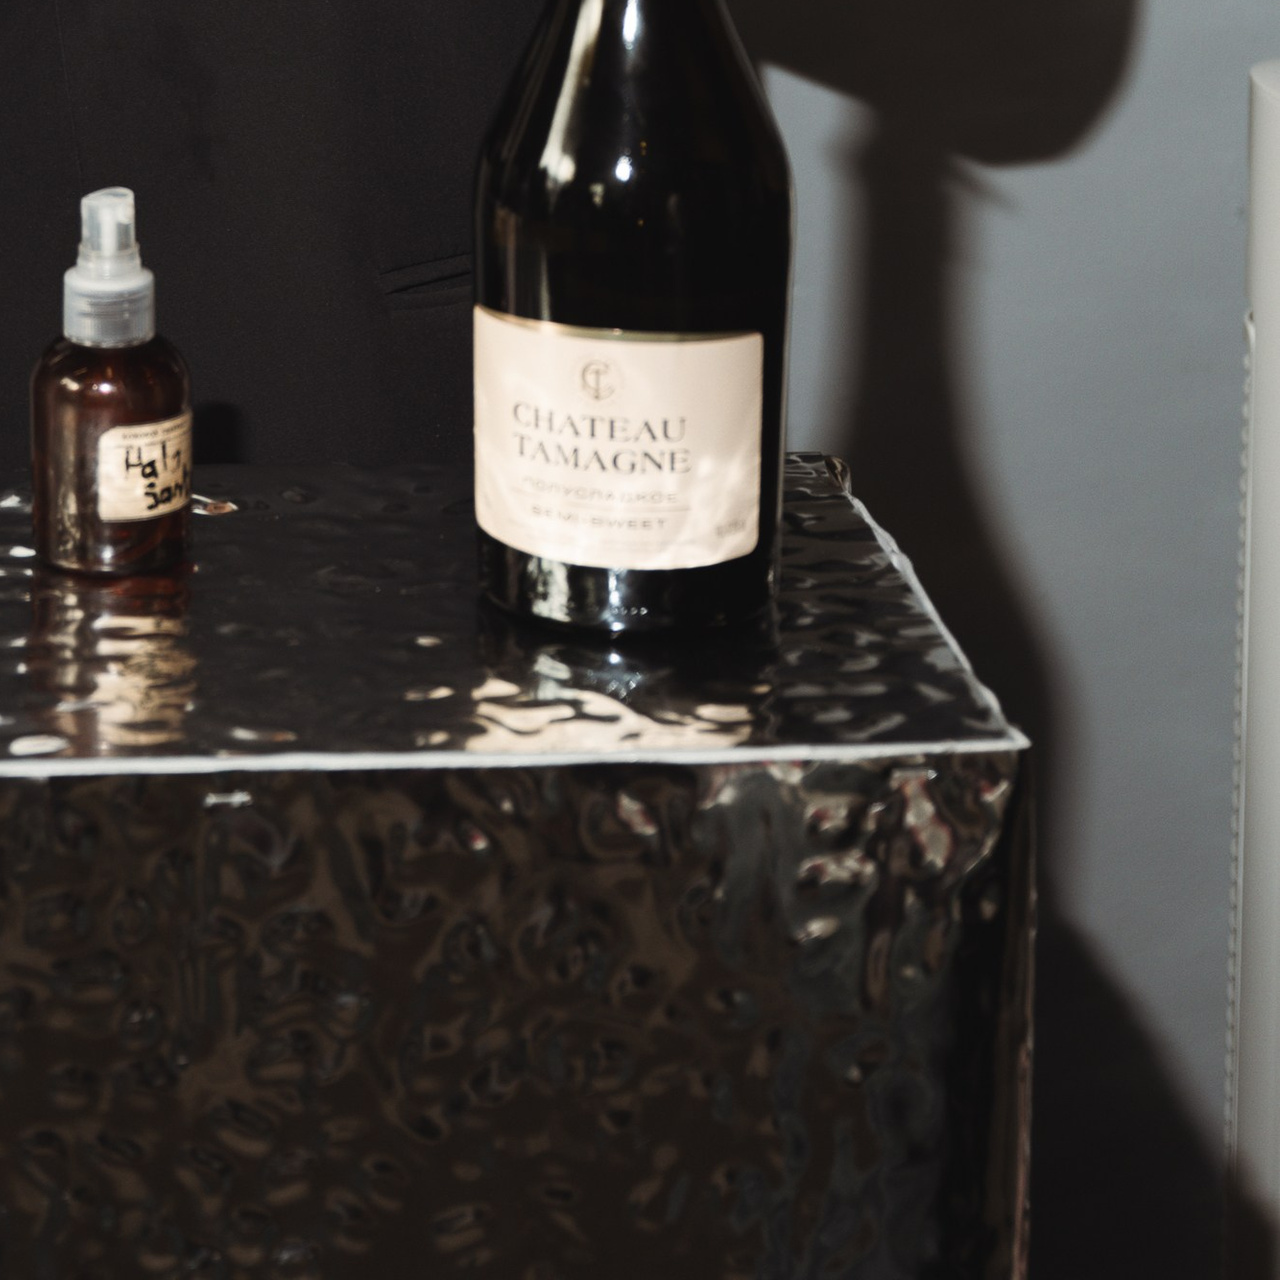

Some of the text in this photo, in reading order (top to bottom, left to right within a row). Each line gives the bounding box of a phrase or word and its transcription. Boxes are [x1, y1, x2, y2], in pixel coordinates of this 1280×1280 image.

[511, 399, 688, 444] CHATEAU
[512, 432, 694, 476] TAMAGNE
[530, 505, 670, 531] SEMI-SWEET
